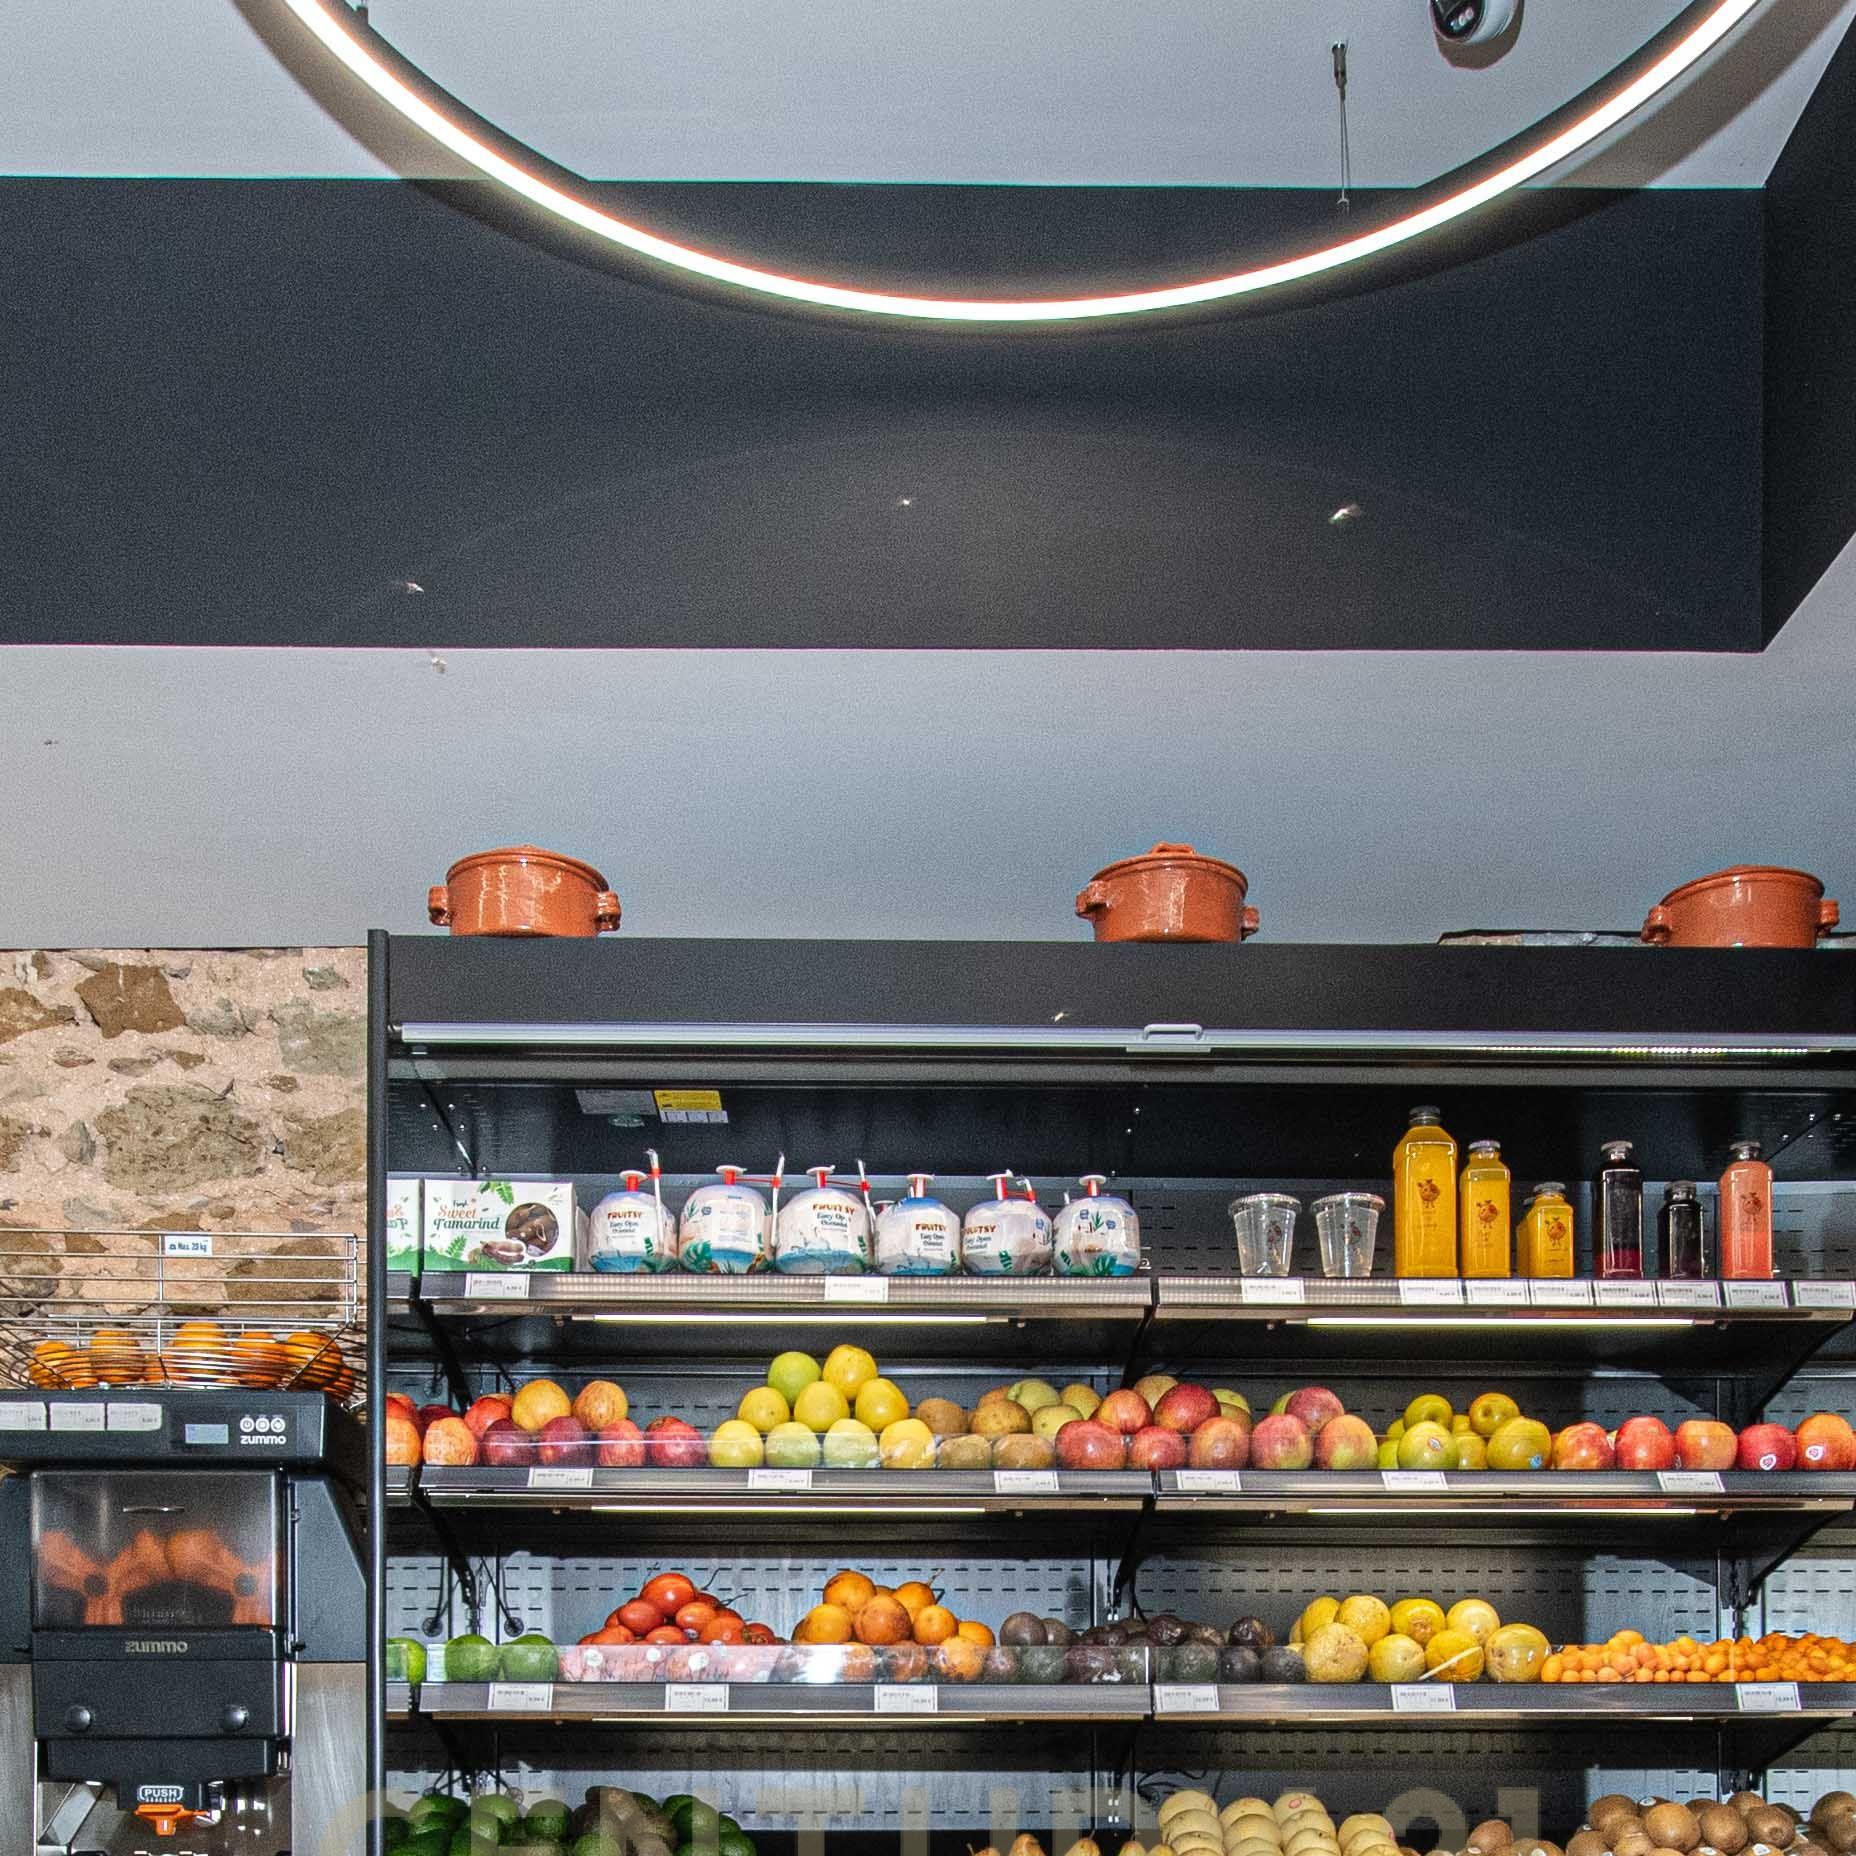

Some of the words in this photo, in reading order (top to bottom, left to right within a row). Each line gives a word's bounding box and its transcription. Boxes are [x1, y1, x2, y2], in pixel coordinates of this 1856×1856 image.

[438, 1204, 477, 1219] Sweet
[607, 1210, 644, 1220] FRUITSY
[812, 1203, 856, 1216] FRUITSY
[433, 1217, 500, 1231] Tamarind
[915, 1223, 948, 1232] FRUITSY
[240, 1435, 286, 1445] zummo
[126, 1641, 188, 1653] zummo
[144, 1788, 177, 1798] PUSH
